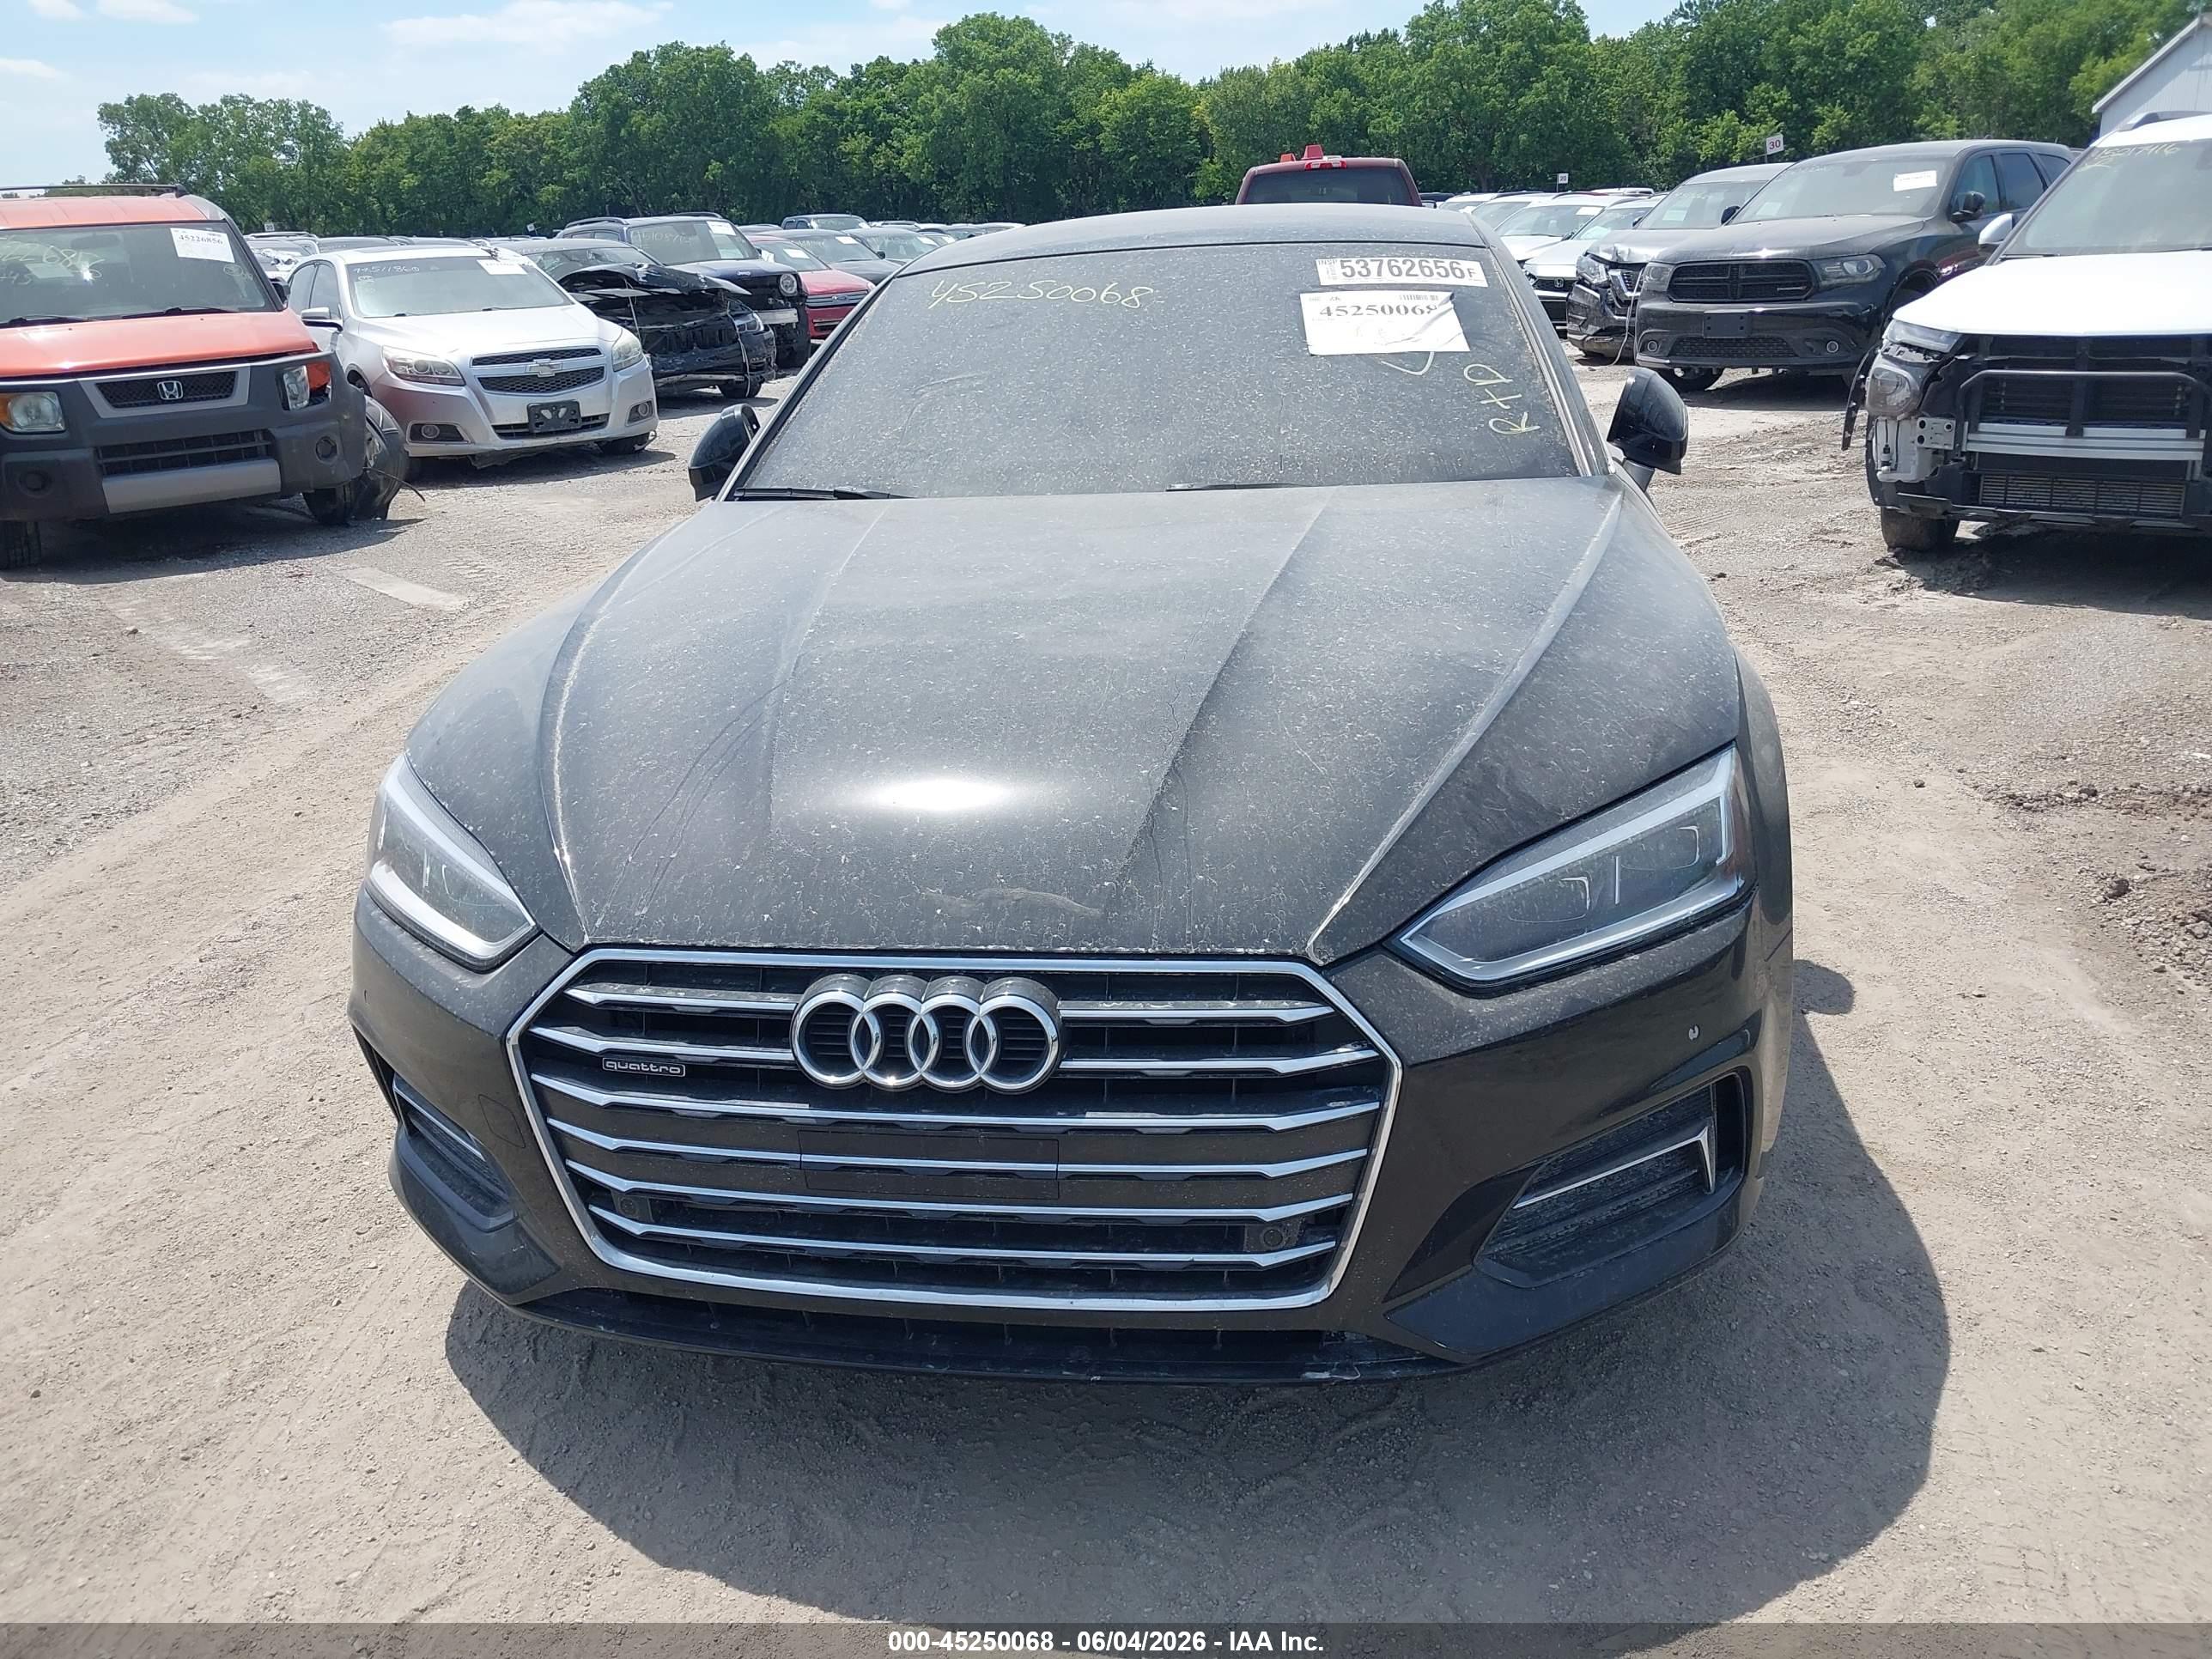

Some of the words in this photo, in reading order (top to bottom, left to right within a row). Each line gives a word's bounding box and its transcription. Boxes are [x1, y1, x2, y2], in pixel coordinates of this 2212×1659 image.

[1769, 139, 1781, 149] 30
[1340, 258, 1465, 279] 53762656
[1467, 268, 1478, 278] F
[928, 280, 1154, 309] 45250068
[605, 1060, 681, 1073] quattro
